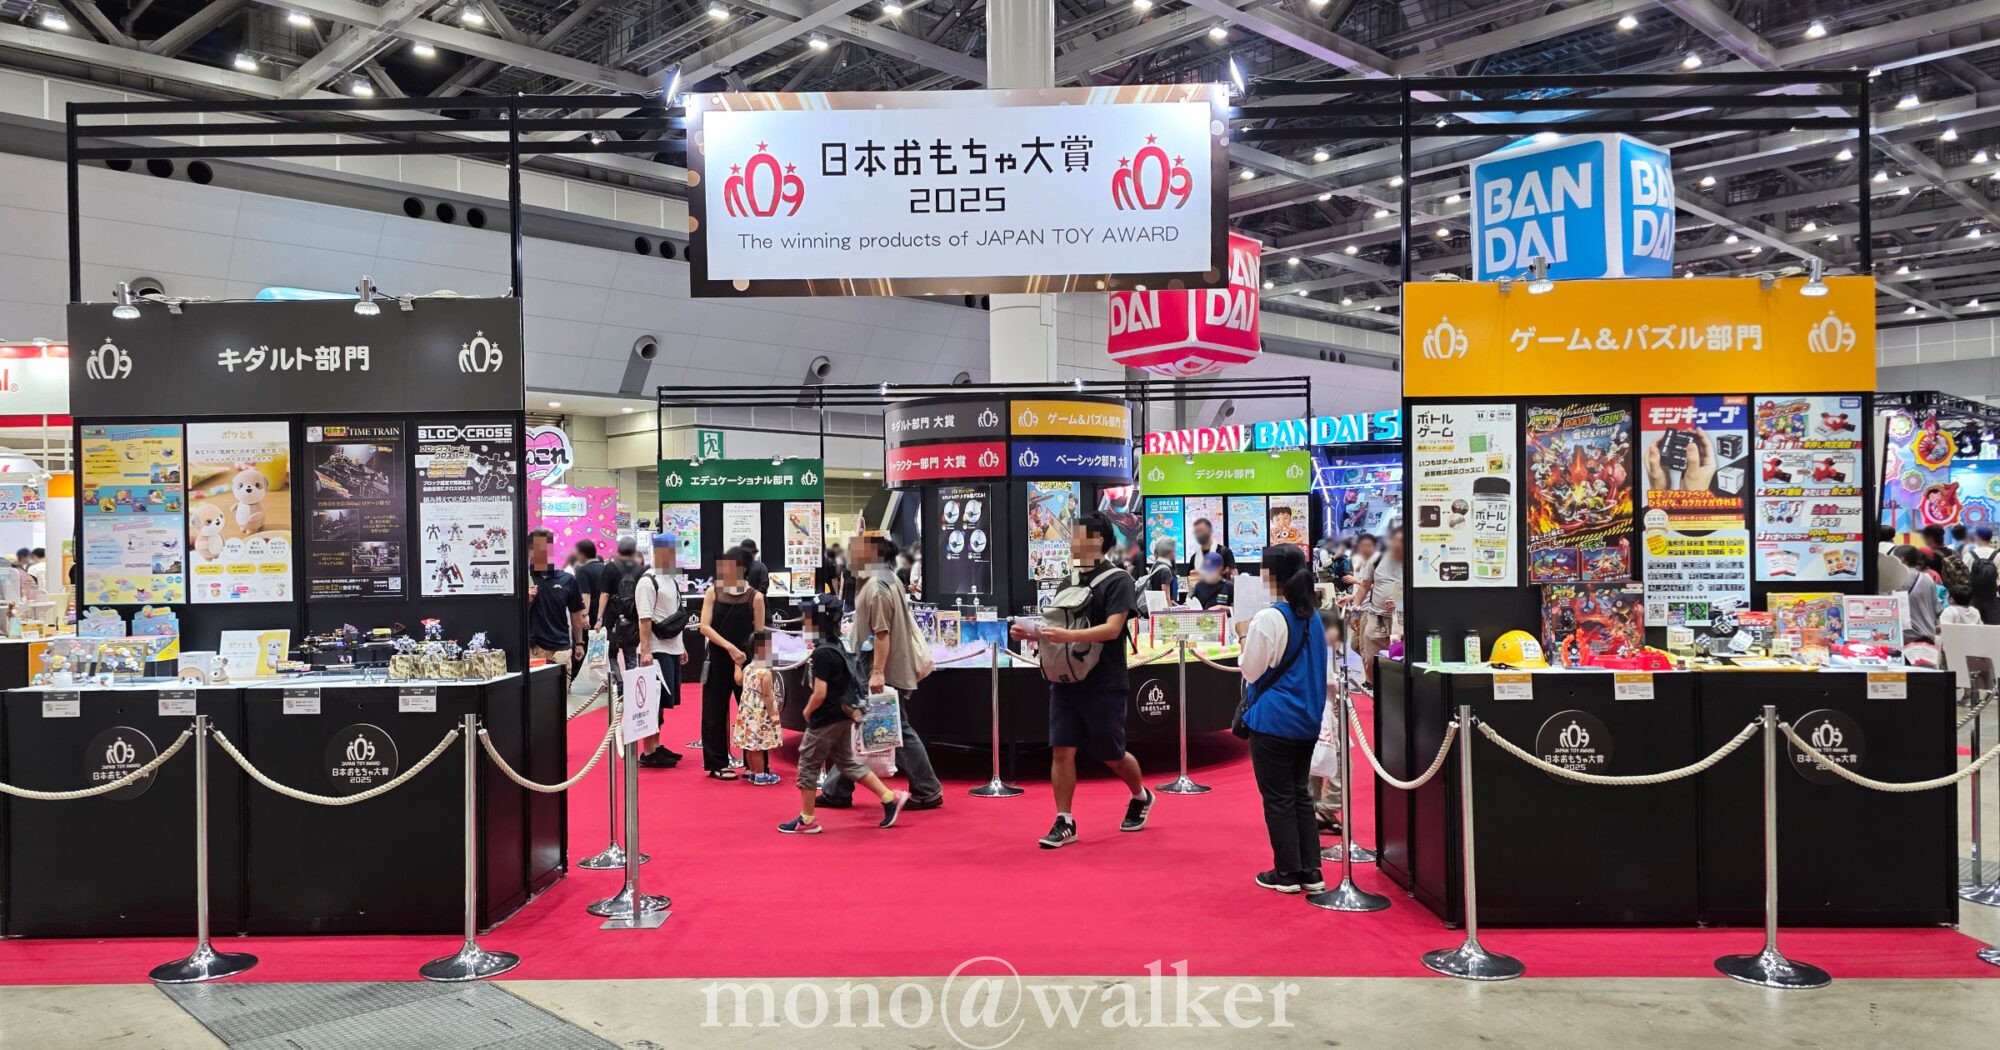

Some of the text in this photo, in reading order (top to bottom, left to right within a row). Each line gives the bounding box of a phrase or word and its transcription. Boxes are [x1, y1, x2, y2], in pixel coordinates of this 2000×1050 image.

[821, 135, 1093, 177] 日本おもちゃ大賞
[910, 187, 1006, 213] 2025
[1484, 162, 1592, 226] BAN
[738, 226, 1179, 250] The winning products of JAPAN TOY AWARD
[1484, 215, 1568, 273] DAI
[1228, 248, 1260, 292] AN
[1111, 290, 1161, 336] DAI
[1206, 289, 1255, 332] DAI
[1510, 324, 1762, 353] ゲーム&パズル部門
[218, 345, 370, 373] キダルト部門
[891, 414, 956, 432] キダルト部門 大賞
[1417, 411, 1454, 424] ボトル
[1649, 406, 1740, 425] モジキューブ
[349, 427, 400, 436] TIME TRAIN
[418, 426, 512, 441] BLOCKCROSS
[1255, 409, 1402, 450] BANDAI S
[1417, 425, 1454, 438] ゲーム
[1144, 424, 1241, 455] BANDAI
[943, 455, 967, 469] 大賞
[1056, 454, 1116, 468] ベーシック部門
[1418, 457, 1474, 467] いつもはゲームセット
[690, 475, 794, 486] エデュケーショナル部門
[1194, 469, 1255, 479] デジタル部門
[1475, 508, 1507, 520] ボトル
[1475, 520, 1506, 532] ゲーム
[1544, 755, 1605, 763] 日本おもちゃ大賞
[1797, 754, 1858, 763] 日本ちゃ大賞
[332, 766, 389, 777] 日本おもちゃ大賞
